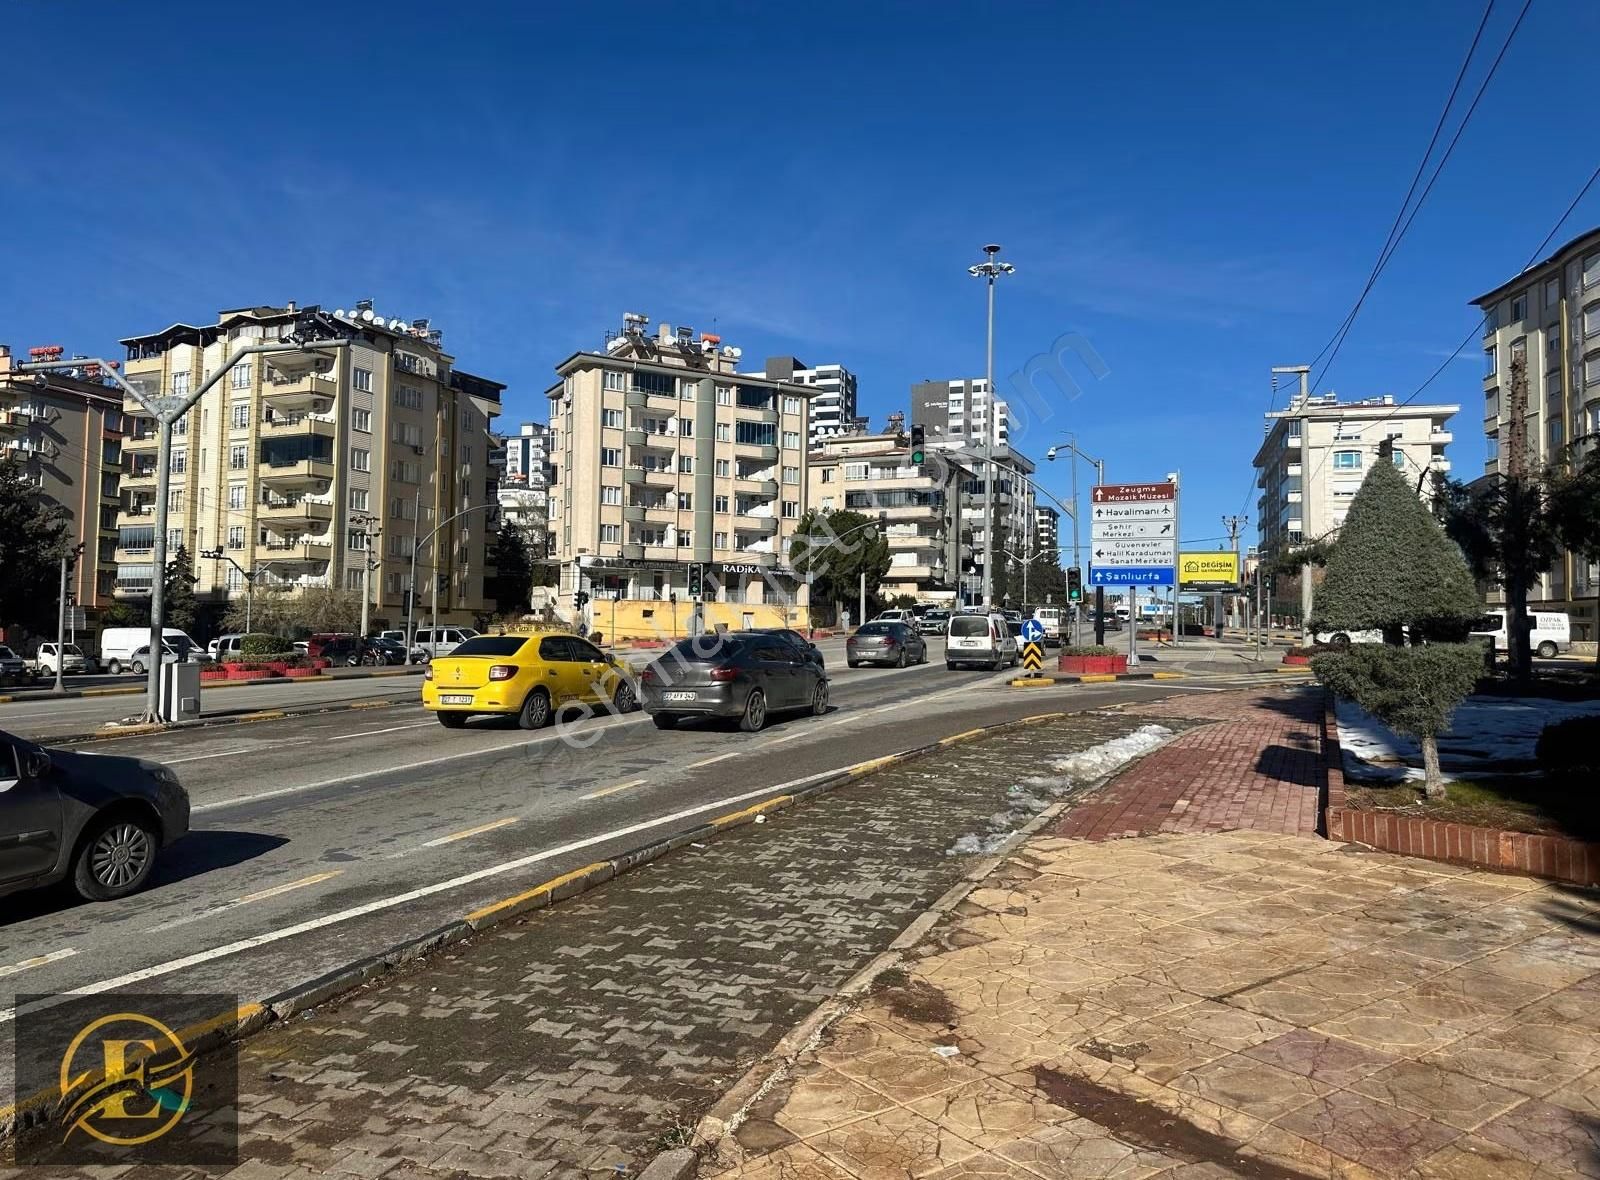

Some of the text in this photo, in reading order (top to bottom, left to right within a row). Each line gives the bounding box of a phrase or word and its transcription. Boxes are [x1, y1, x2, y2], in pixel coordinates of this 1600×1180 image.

[1119, 486, 1157, 494] Zeugma
[1108, 492, 1169, 501] Mozaik Müzesi
[1106, 508, 1160, 516] Havalimanı
[1108, 523, 1132, 531] Şehir
[1200, 560, 1232, 569] DEĞİŞİM
